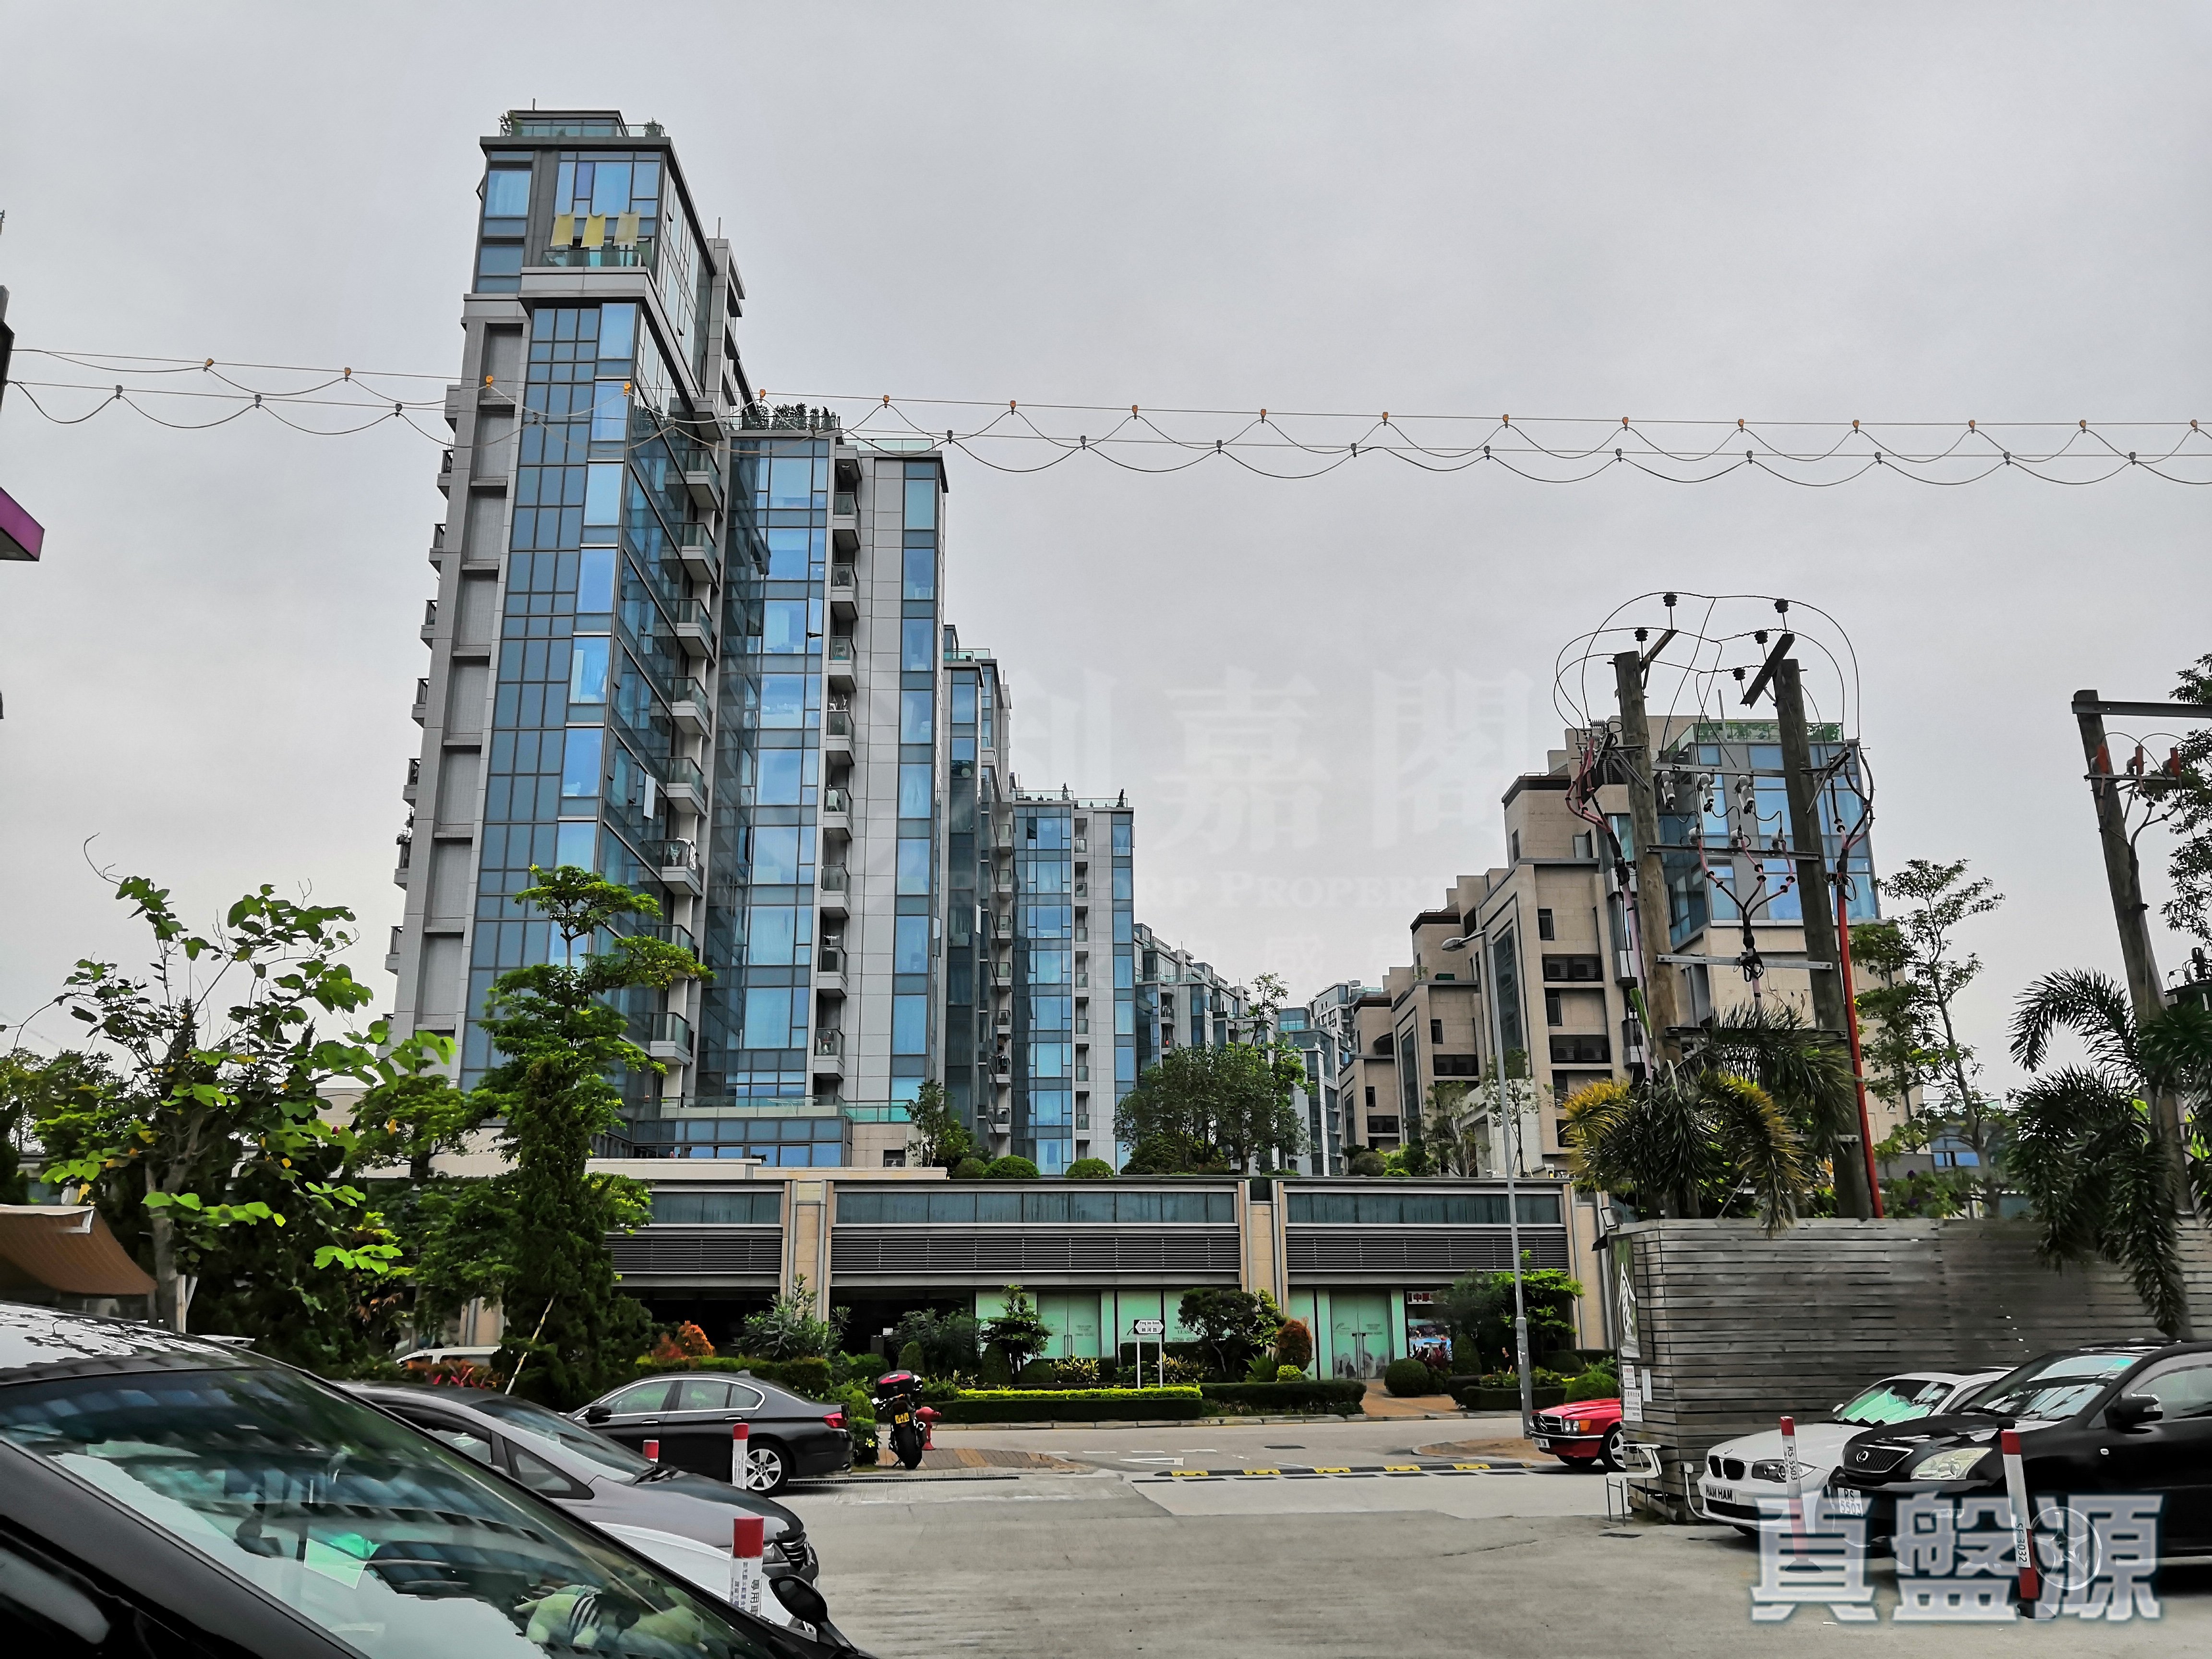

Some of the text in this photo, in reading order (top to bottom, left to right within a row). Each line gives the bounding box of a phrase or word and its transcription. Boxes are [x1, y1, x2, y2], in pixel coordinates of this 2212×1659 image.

[1787, 1446, 1798, 1480] RS 5503
[1718, 1488, 1733, 1502] HAM
[1844, 1489, 1855, 1502] RS
[1840, 1500, 1862, 1516] 5503
[2015, 1523, 2027, 1563] SF 3032
